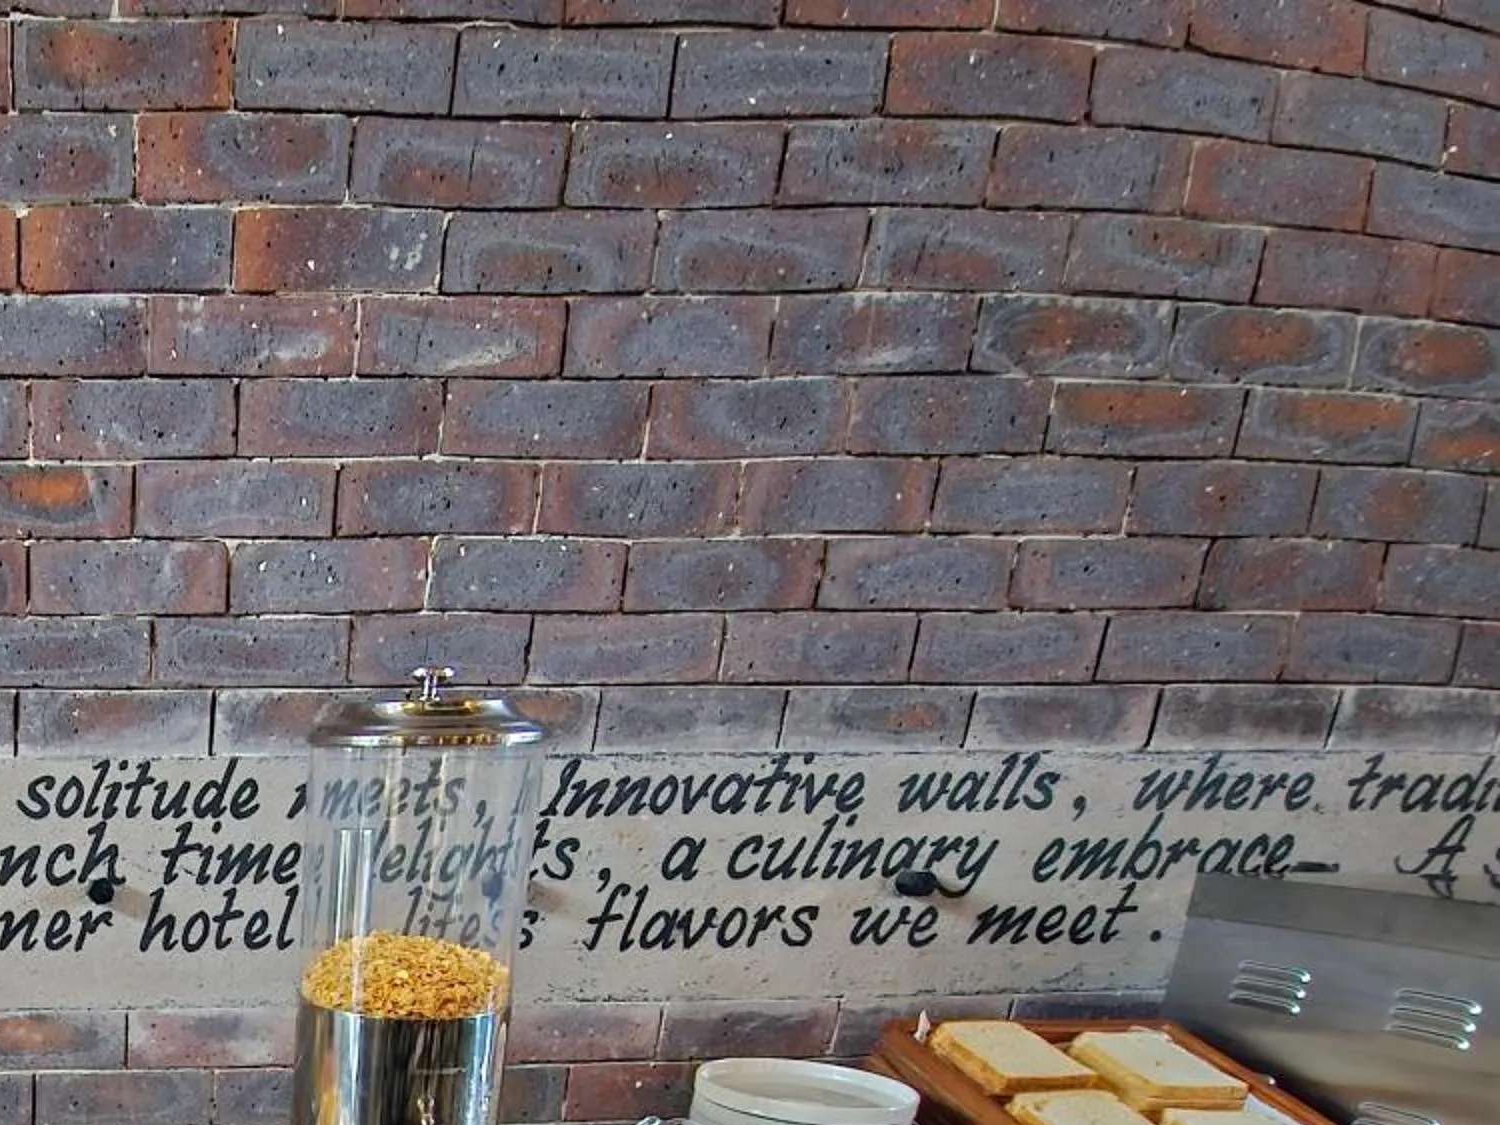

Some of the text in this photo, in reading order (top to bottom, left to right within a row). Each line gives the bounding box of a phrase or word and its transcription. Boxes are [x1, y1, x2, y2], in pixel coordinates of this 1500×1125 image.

[16, 757, 261, 823] solitude
[538, 752, 865, 820] Innovative
[897, 751, 1087, 821] walls,
[1133, 752, 1315, 812] where
[1347, 752, 1500, 814] tradi
[160, 820, 301, 887] time
[661, 836, 703, 882] a
[726, 812, 999, 899] culinary
[139, 884, 300, 953] hotel
[582, 882, 821, 954] flavors
[849, 900, 939, 950] we
[965, 881, 1163, 946] meet.
